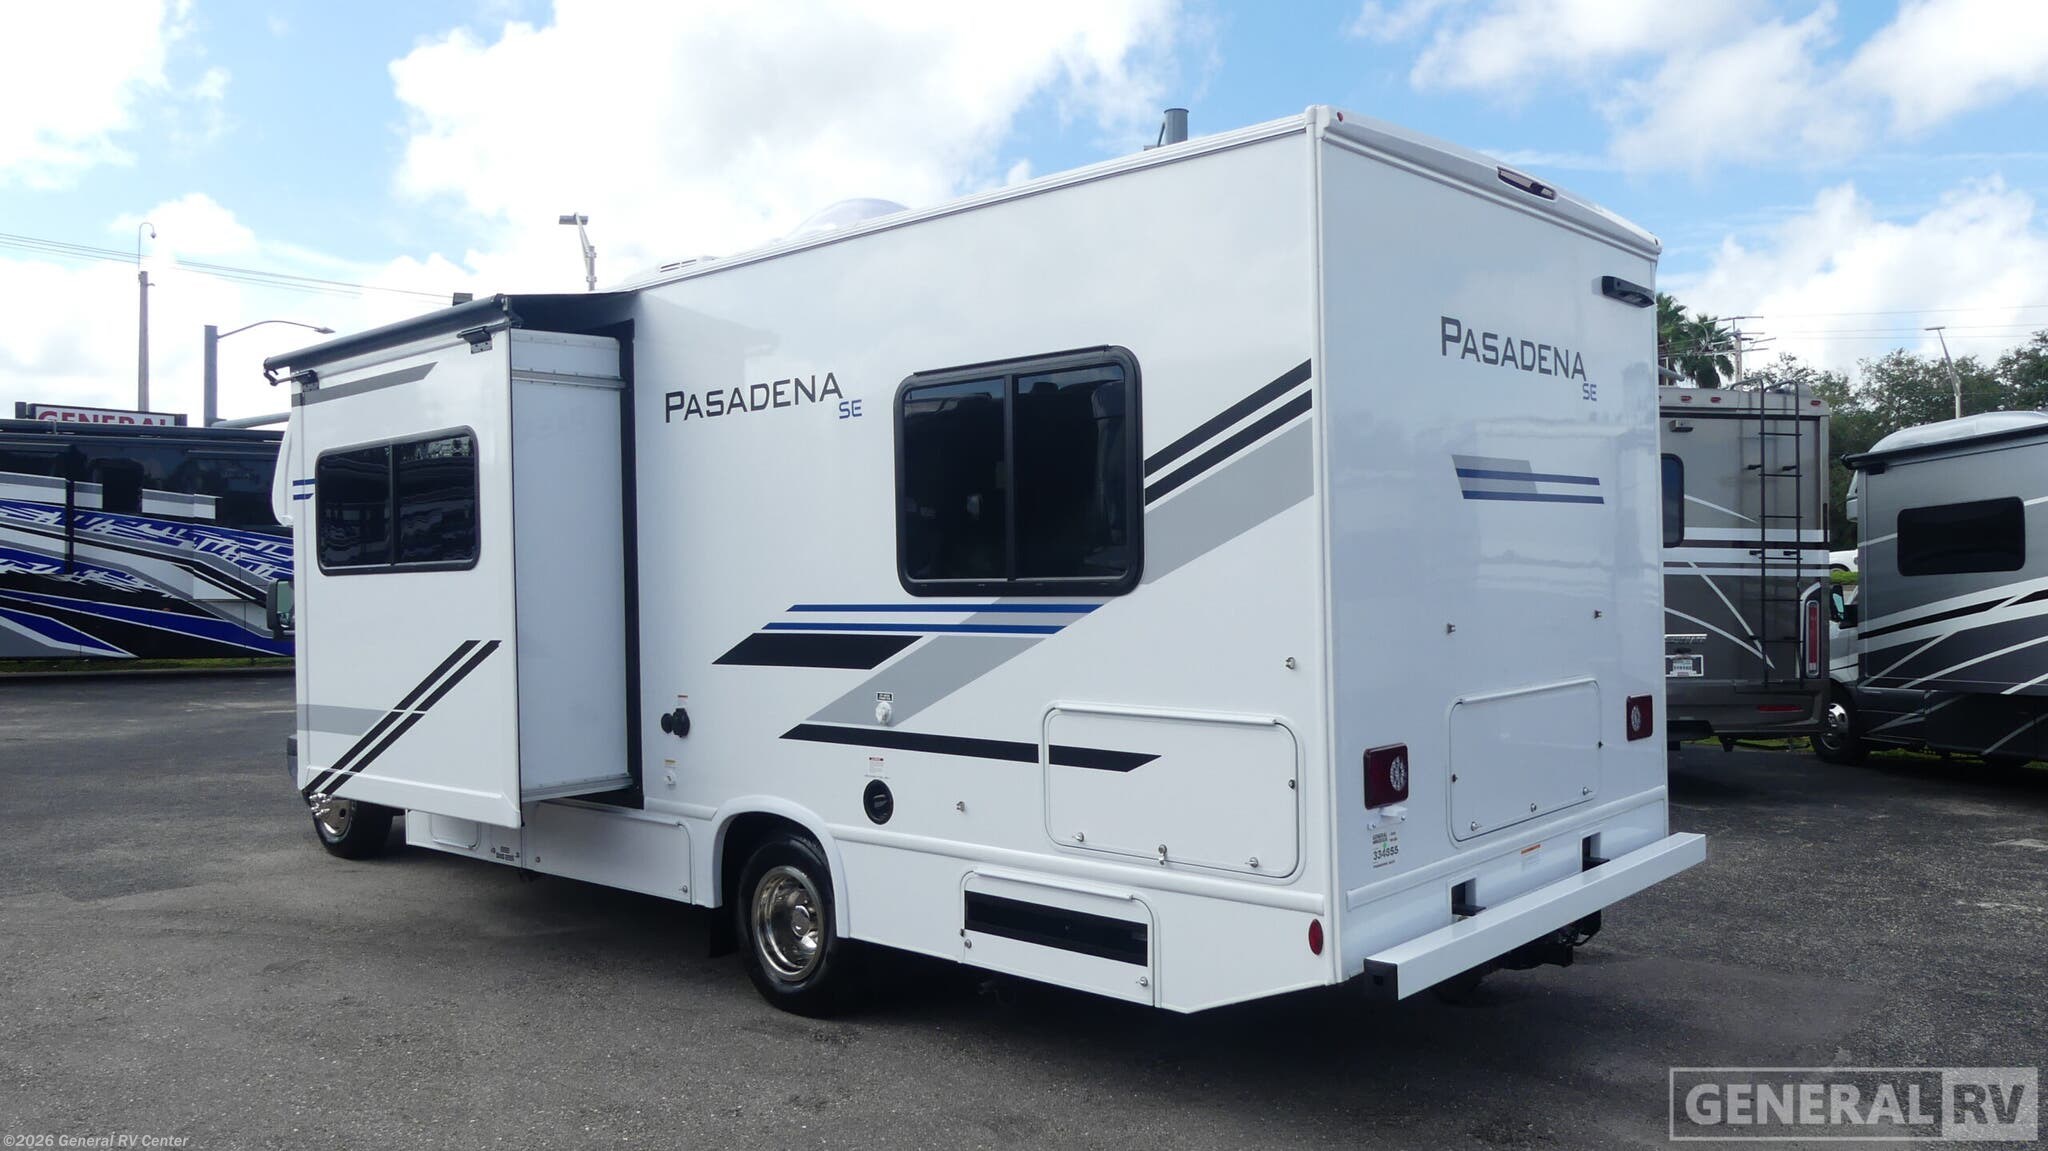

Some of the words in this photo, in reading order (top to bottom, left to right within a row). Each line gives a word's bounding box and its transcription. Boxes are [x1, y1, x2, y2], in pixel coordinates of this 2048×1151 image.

[1440, 315, 1587, 382] PASADENA
[1582, 382, 1598, 402] SE
[665, 372, 844, 424] PASADENA
[839, 399, 863, 420] SE
